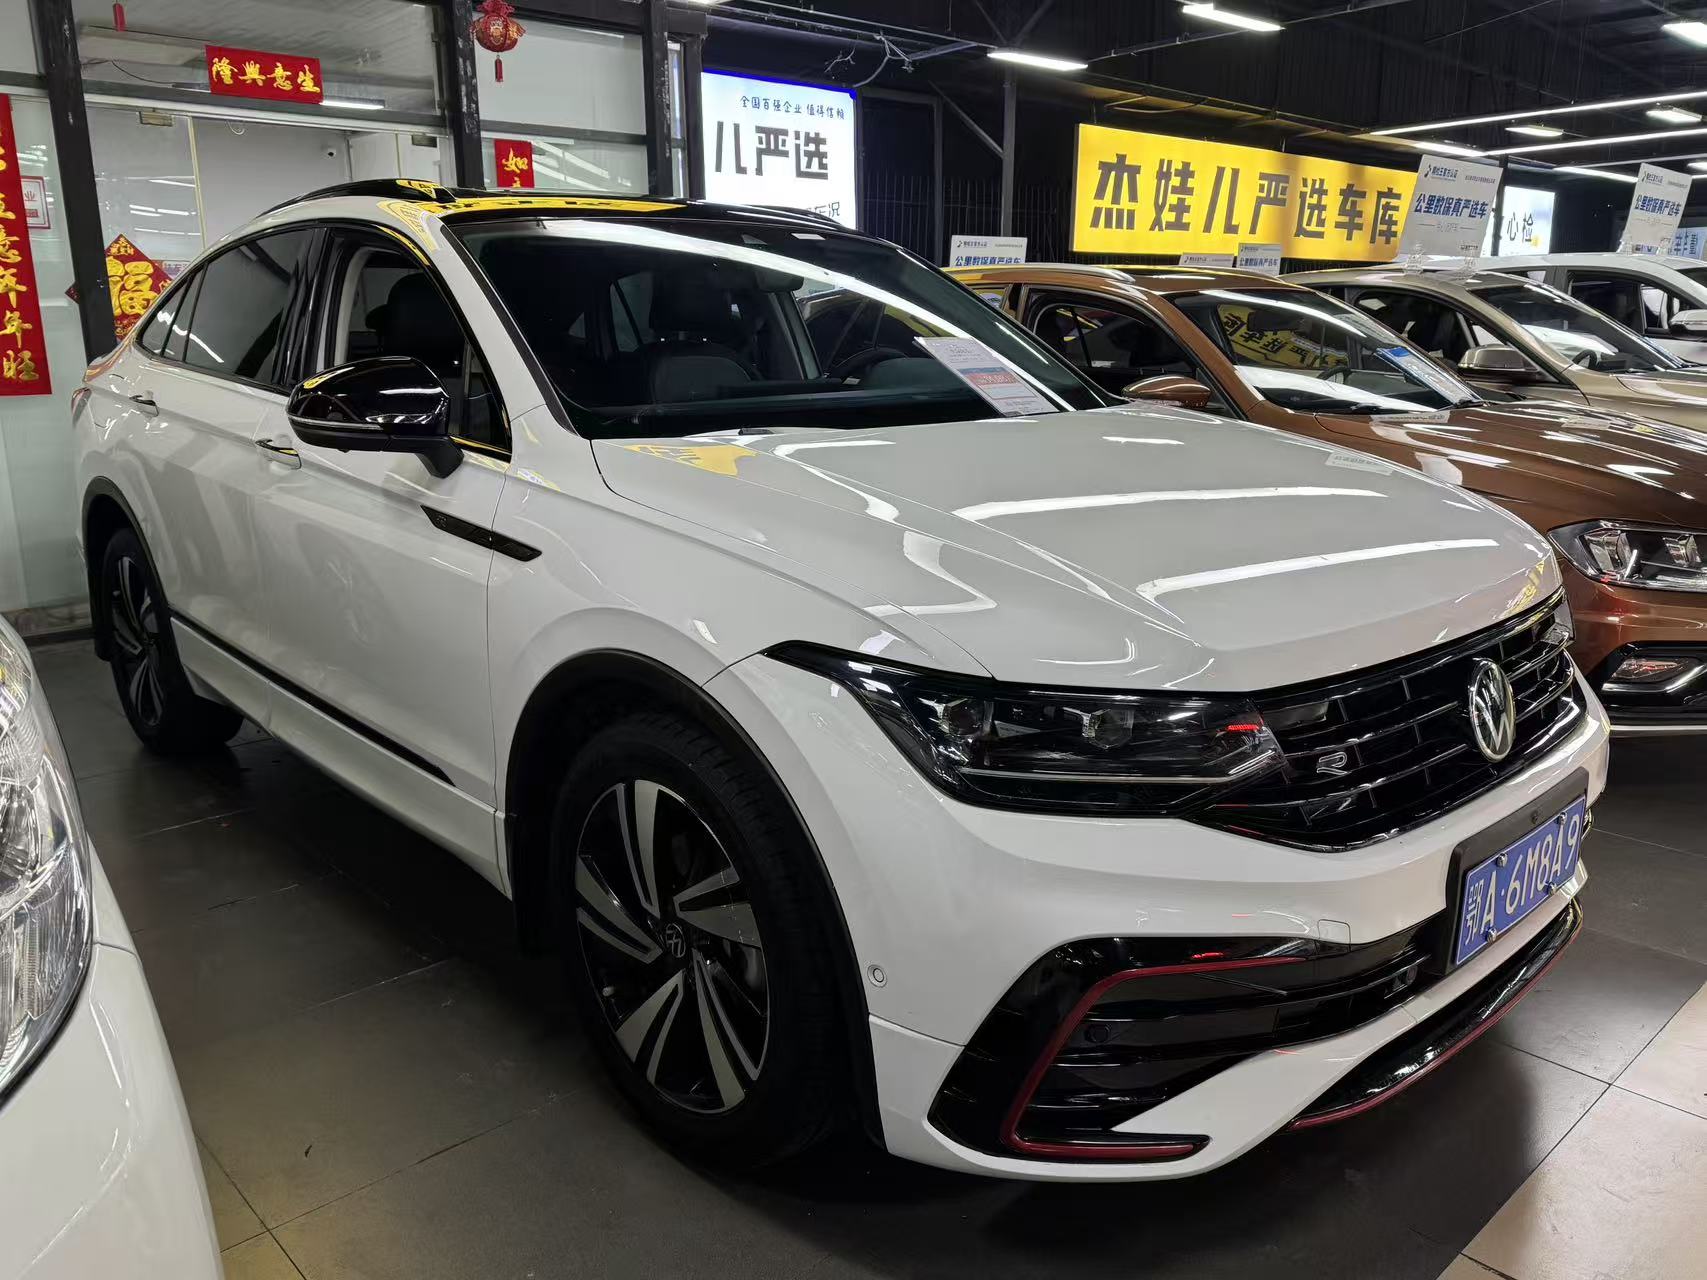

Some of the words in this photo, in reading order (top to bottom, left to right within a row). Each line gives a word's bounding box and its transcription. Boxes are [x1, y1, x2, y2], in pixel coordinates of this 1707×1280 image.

[740, 95, 802, 114] 全国百强企业
[715, 121, 828, 180] 儿严选
[1090, 153, 1402, 245] 杰娃儿严选车库
[1414, 193, 1488, 219] 公里数保真严选车
